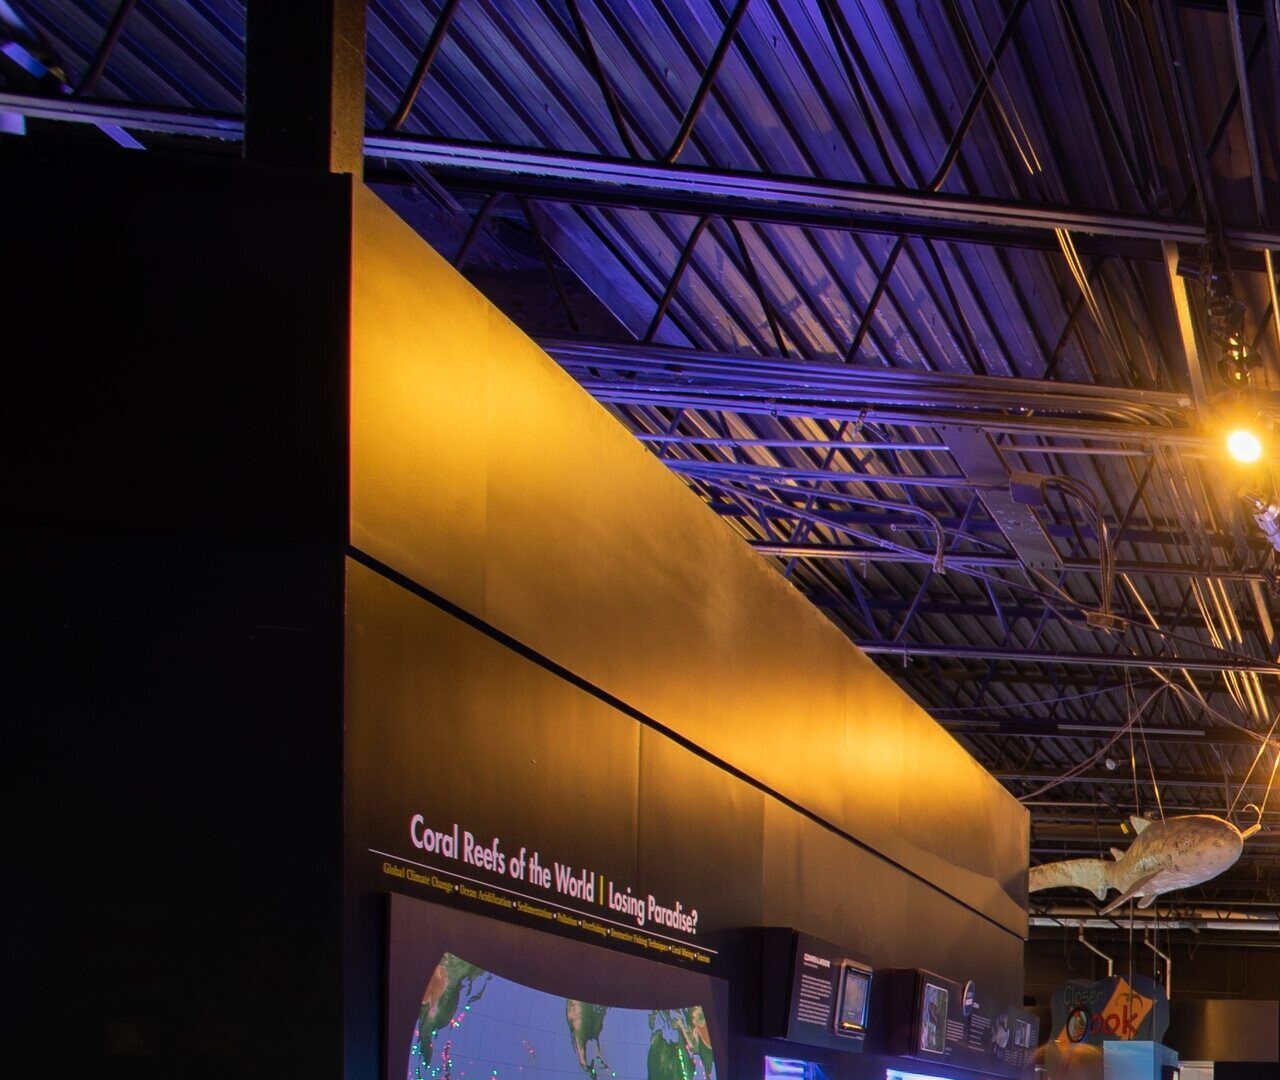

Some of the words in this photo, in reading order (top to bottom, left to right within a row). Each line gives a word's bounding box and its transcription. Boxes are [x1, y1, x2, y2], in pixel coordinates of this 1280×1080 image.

[410, 813, 459, 860] Coral
[464, 831, 506, 875] Reefs
[509, 847, 526, 880] of
[529, 852, 552, 889] the
[554, 862, 595, 902] World
[609, 881, 645, 926] Losing
[648, 894, 698, 935] Paradise?
